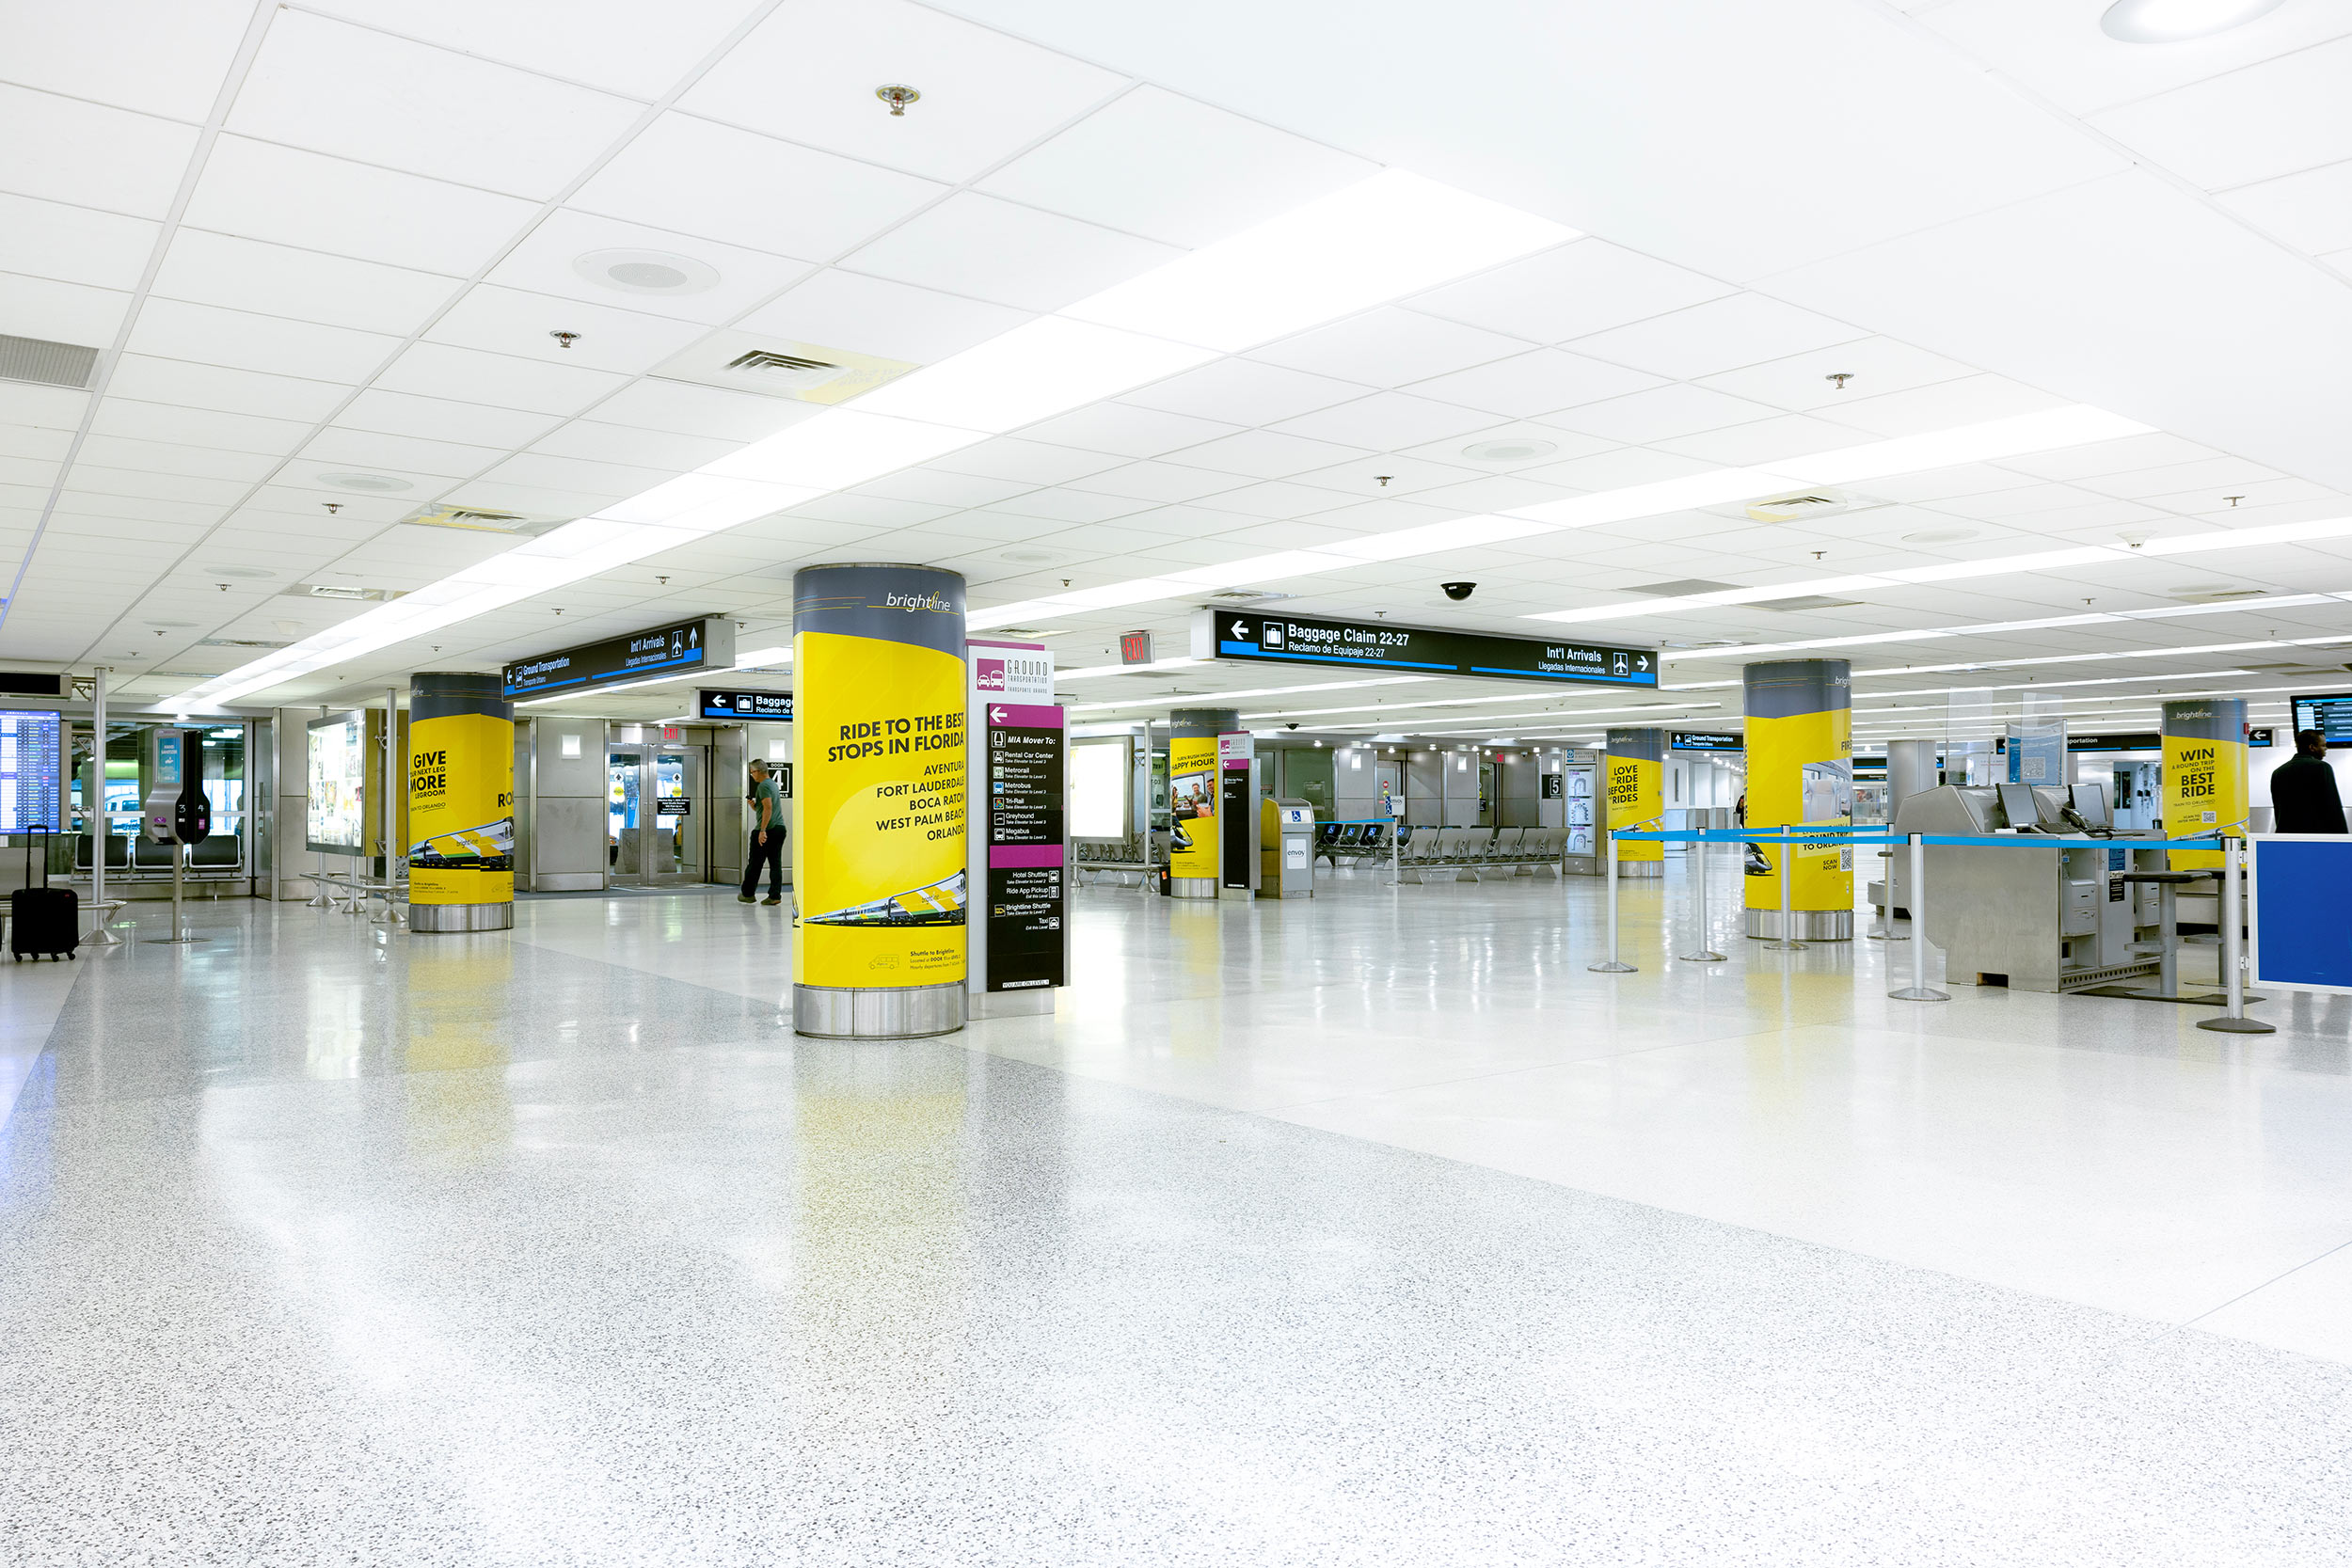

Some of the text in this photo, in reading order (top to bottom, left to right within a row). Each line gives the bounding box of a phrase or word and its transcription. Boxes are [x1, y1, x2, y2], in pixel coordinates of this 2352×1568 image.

[886, 591, 950, 612] brightline
[1288, 624, 1409, 646] Baggage Claim 22-27
[631, 635, 665, 653] Int'l Arrivals
[1124, 637, 1144, 660] EXIT
[1288, 641, 1385, 657] Reclamo de Equipaje 22-27
[1547, 646, 1602, 662] Int'l Arrivals
[524, 657, 570, 676] Ground Transportation
[1007, 659, 1048, 676] GROUND
[1538, 661, 1605, 674] Llegadas Internacionales
[2176, 709, 2212, 720] brightline
[664, 728, 678, 740] EXIT
[840, 712, 964, 741] RIDE TO THE BEST
[828, 731, 964, 763] STOPS IN FLORIDA
[1841, 739, 1852, 751] FIRS
[414, 751, 446, 768] GIVE
[1191, 758, 1214, 767] HOUR
[2180, 748, 2214, 761] WIN
[924, 760, 964, 776] AVENTURA
[1614, 765, 1638, 776] LOVE
[410, 774, 446, 792] MORE
[877, 775, 964, 798] FORT LAUDERDALE
[1553, 780, 1559, 794] 5
[1617, 774, 1638, 784] RIDE
[2182, 772, 2215, 786] BEST
[415, 789, 446, 799] LEGROOM
[1608, 784, 1638, 796] BEFORE
[2182, 784, 2215, 798] RIDE
[910, 792, 964, 810] BOCA RATON
[1612, 793, 1638, 804] RIDES
[178, 805, 186, 813] 3
[876, 808, 964, 832] WEST PALM BEACH
[927, 824, 964, 841] ORLANDO
